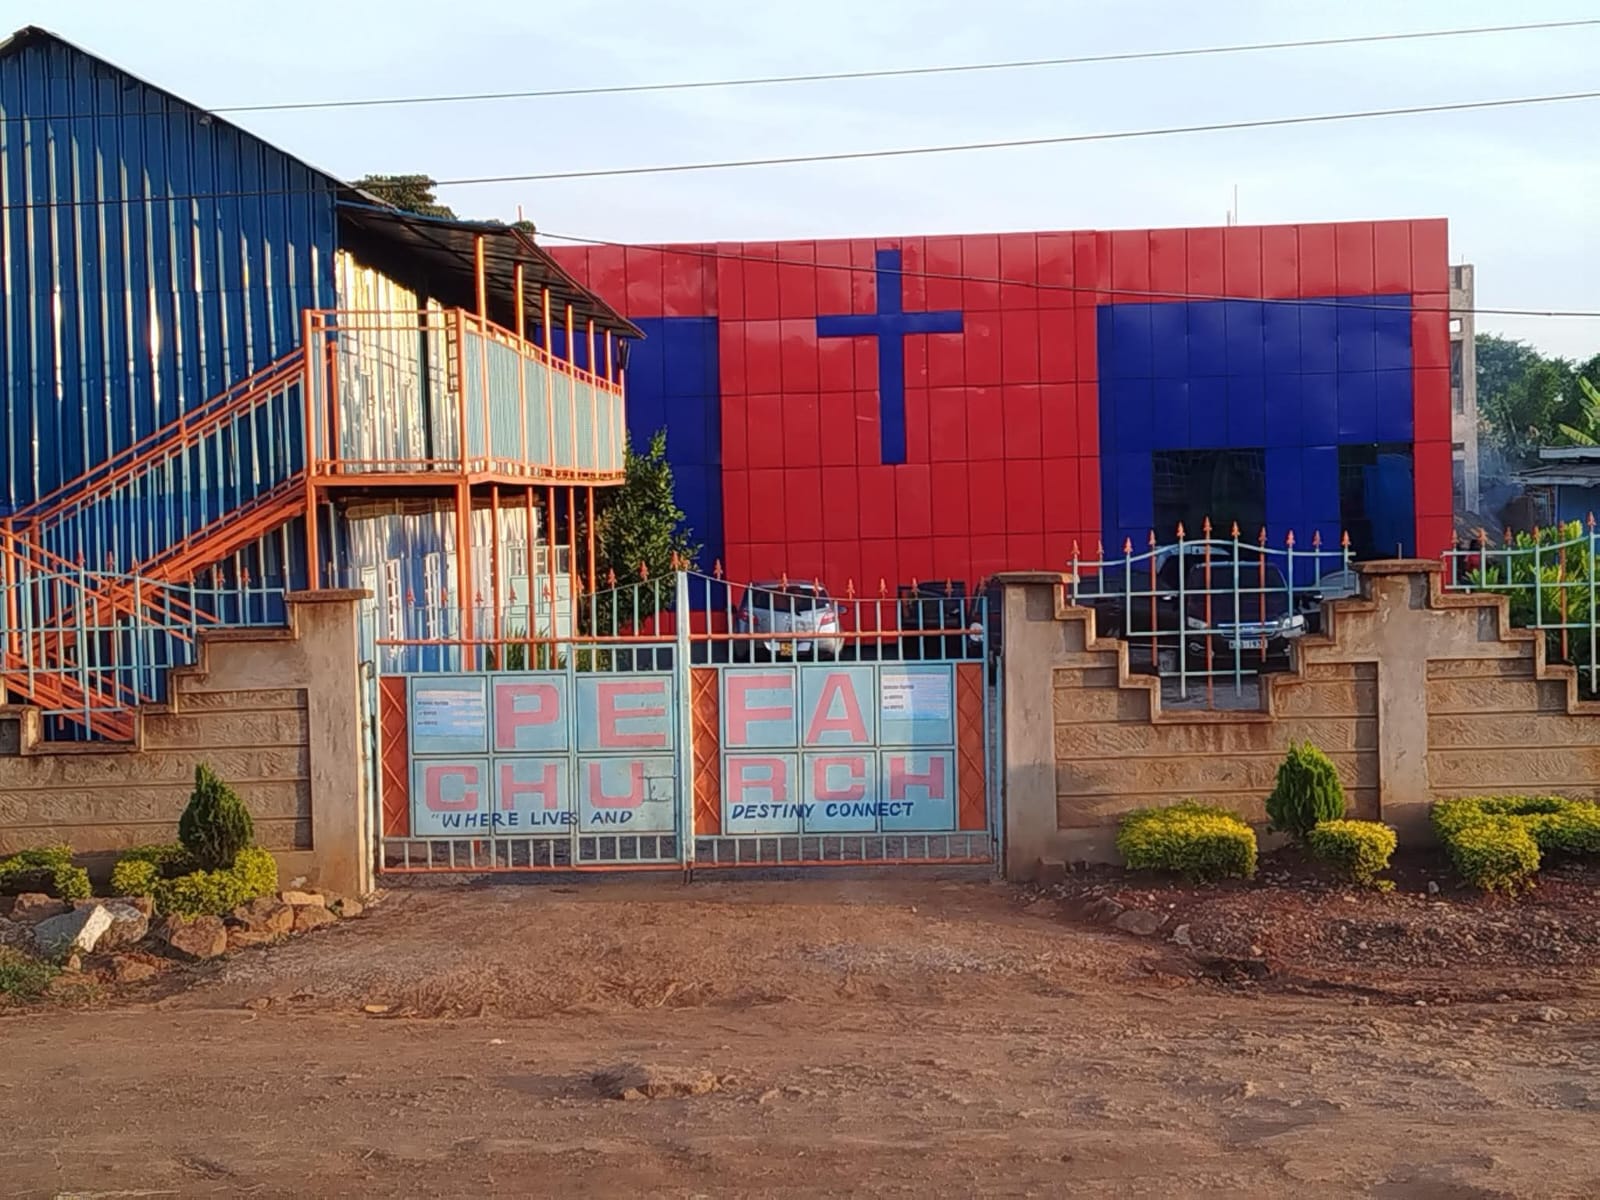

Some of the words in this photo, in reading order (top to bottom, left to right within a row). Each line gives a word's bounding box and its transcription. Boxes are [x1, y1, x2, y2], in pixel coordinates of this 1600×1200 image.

[496, 673, 869, 748] PEFA
[425, 756, 945, 811] CHURCH
[530, 811, 578, 826] LIVES
[590, 810, 633, 825] AND
[731, 802, 815, 820] DESTINY
[825, 801, 915, 818] CONNECT
